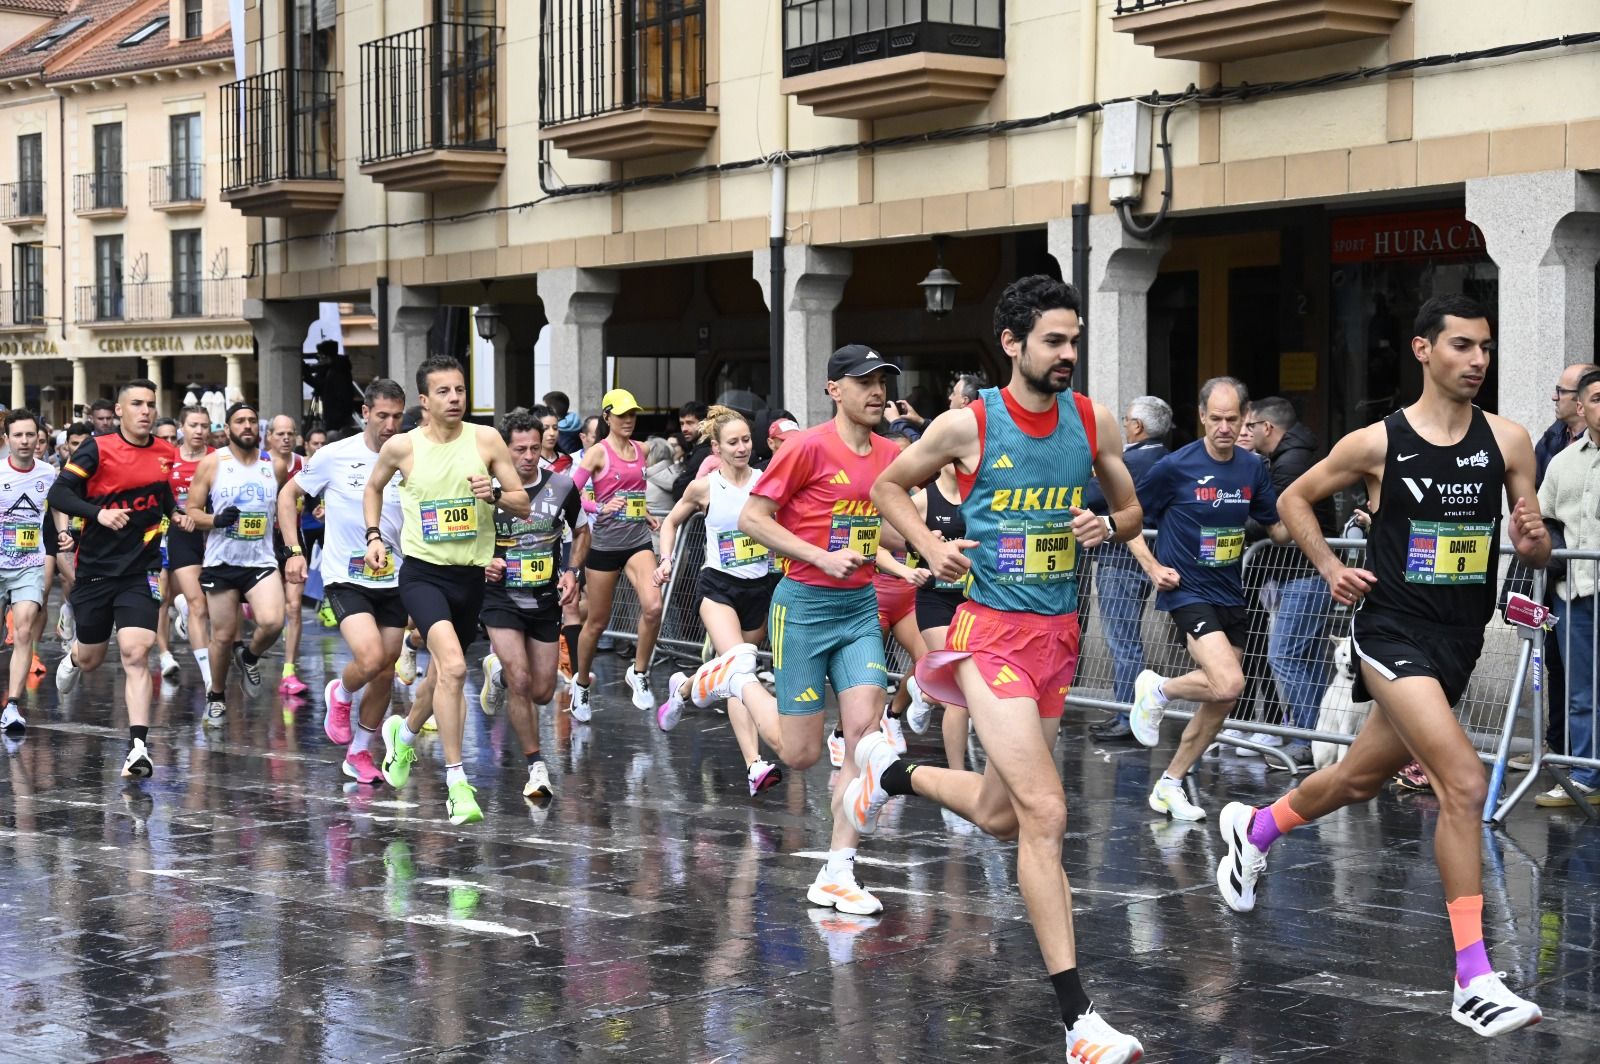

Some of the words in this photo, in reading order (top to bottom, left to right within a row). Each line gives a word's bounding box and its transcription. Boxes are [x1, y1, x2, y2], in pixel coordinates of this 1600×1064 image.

[1334, 238, 1366, 253] SPORT
[22, 340, 58, 355] PLAZA
[194, 334, 253, 351] ASADOR
[1195, 486, 1217, 501] 10K
[1436, 482, 1484, 495] VICKY
[1441, 496, 1479, 505] FOODS
[444, 508, 469, 523] 208
[244, 519, 262, 529] 566
[22, 530, 35, 541] 176
[862, 542, 871, 555] 11
[1035, 536, 1069, 553] ROSADO
[1216, 538, 1229, 548] ABEL
[1449, 539, 1477, 554] DANIEL
[749, 547, 754, 557] 7
[1228, 549, 1233, 558] 1
[530, 560, 545, 573] 90
[1047, 555, 1056, 571] 5
[1457, 556, 1466, 573] 8
